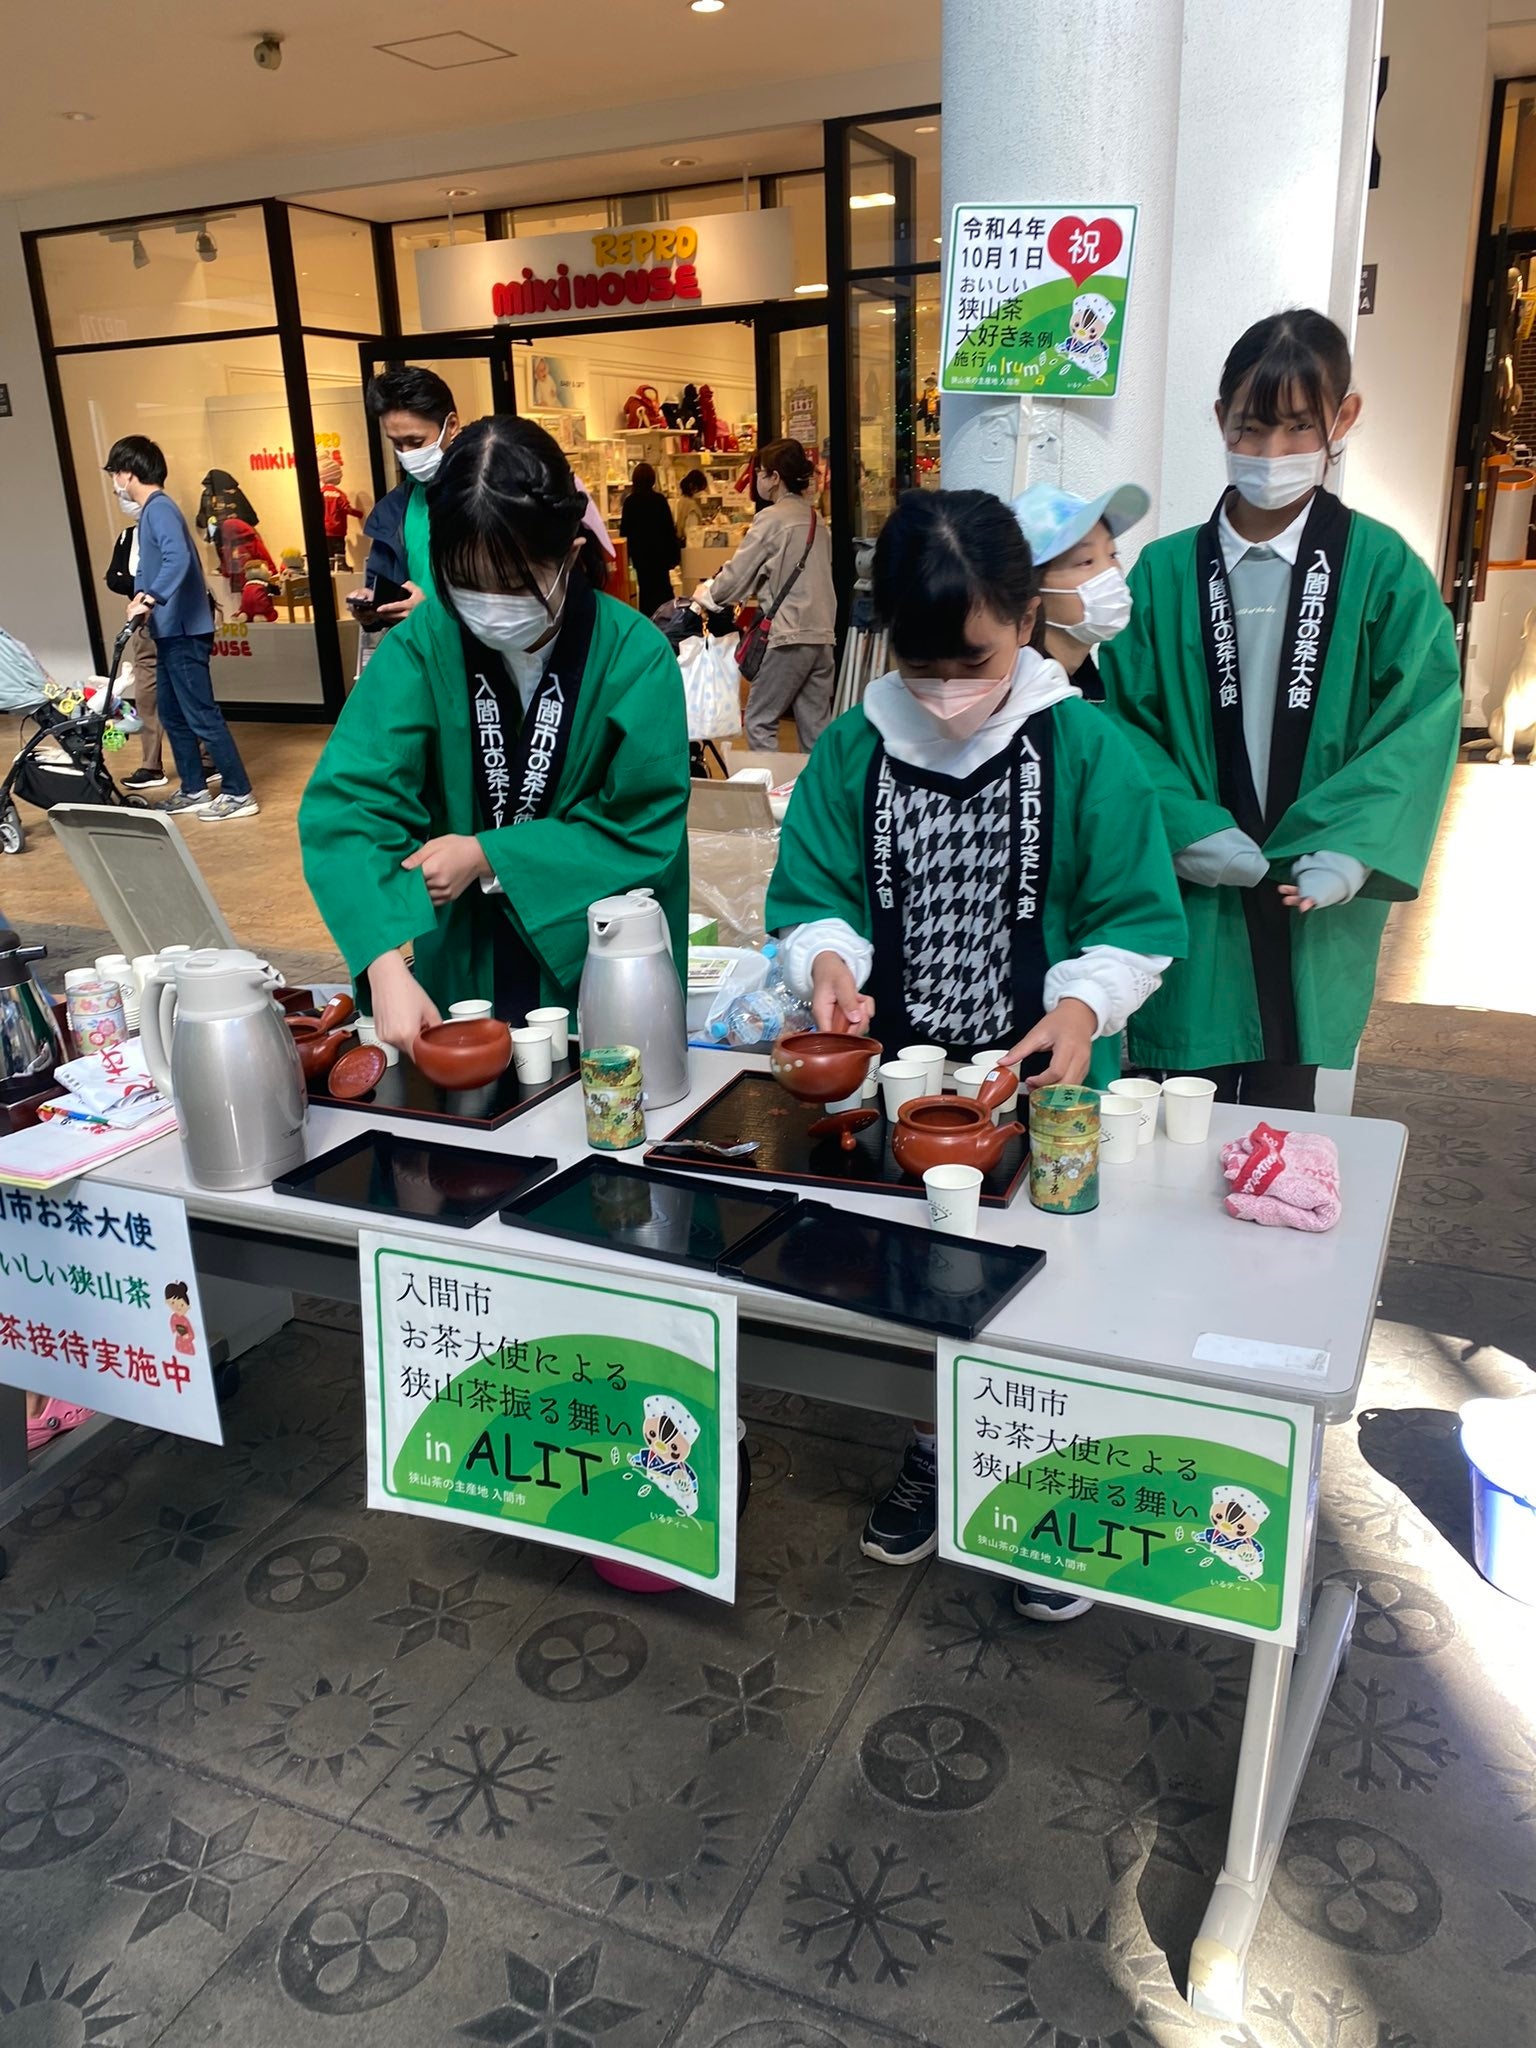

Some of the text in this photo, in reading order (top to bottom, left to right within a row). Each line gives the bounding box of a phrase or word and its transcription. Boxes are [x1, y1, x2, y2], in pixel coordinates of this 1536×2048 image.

[592, 225, 698, 268] REPRO
[963, 216, 1046, 241] 令和4年
[1067, 228, 1101, 265] 祝
[962, 246, 1044, 271] 10月1日
[573, 264, 702, 309] HOUSE
[960, 276, 1028, 294] おいしい
[958, 297, 1023, 322] 狭山茶
[956, 323, 1054, 349] 大好き条例
[953, 351, 987, 368] 施行
[986, 363, 997, 374] in
[1287, 549, 1331, 710] 入間市お茶大使
[396, 1272, 491, 1316] 入間市
[400, 1320, 628, 1392] お茶大使による
[400, 1365, 633, 1438] 狭山茶振る舞い
[973, 1376, 1068, 1417] 入間市
[425, 1430, 603, 1496] in ALIT
[975, 1415, 1198, 1482] お茶大使による
[408, 1471, 527, 1507] 狭山茶の主産地 入間市
[972, 1450, 1199, 1518] 狭山茶振る舞い
[650, 1511, 690, 1530] いるティー
[994, 1506, 1167, 1567] in ALIT
[977, 1534, 1088, 1573] 狭山茶の主産地 入間市
[1210, 1578, 1252, 1592] いるティー
